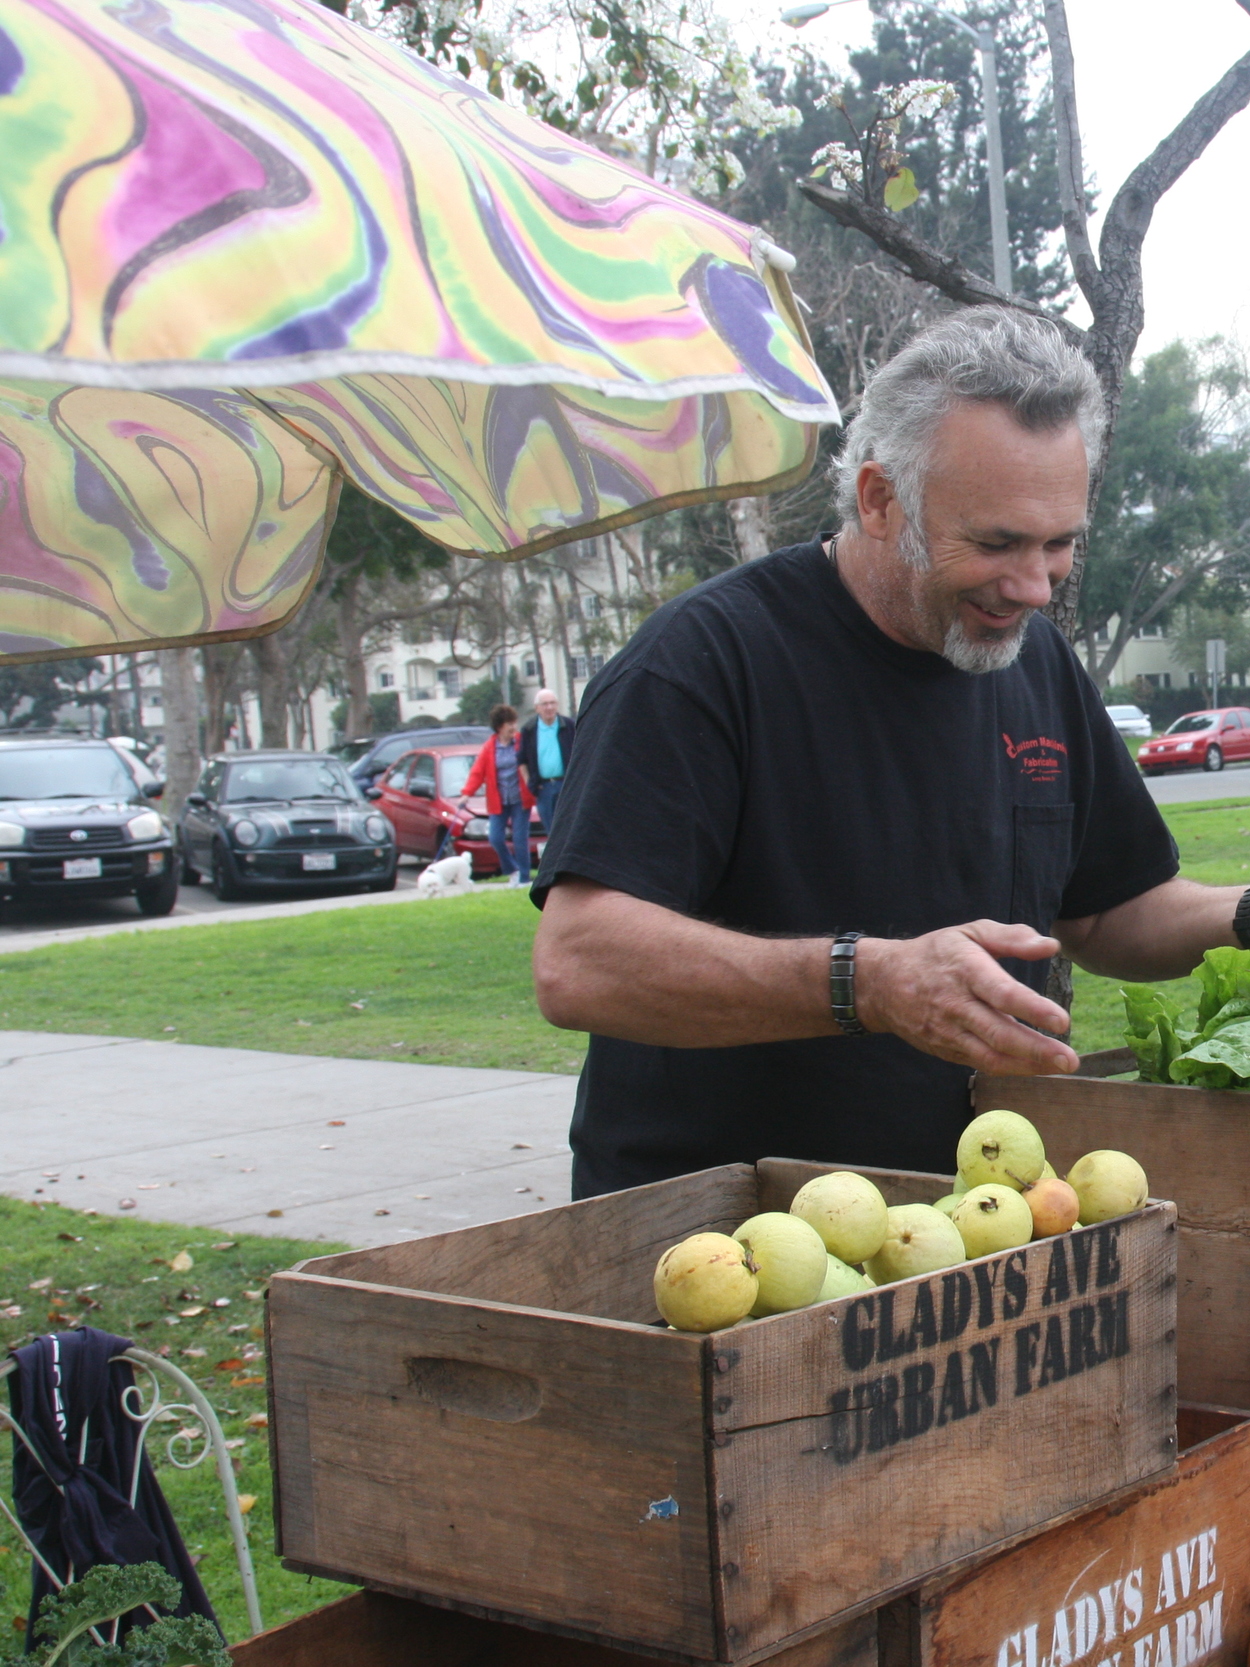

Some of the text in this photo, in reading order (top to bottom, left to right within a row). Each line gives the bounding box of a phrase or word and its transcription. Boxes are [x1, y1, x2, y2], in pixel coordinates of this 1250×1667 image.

[843, 1223, 1122, 1372] GLADYS AVE
[829, 1292, 1131, 1464] URBAN FARM
[997, 1527, 1218, 1667] GLADYS AVE
[1134, 1591, 1224, 1667] FARM
